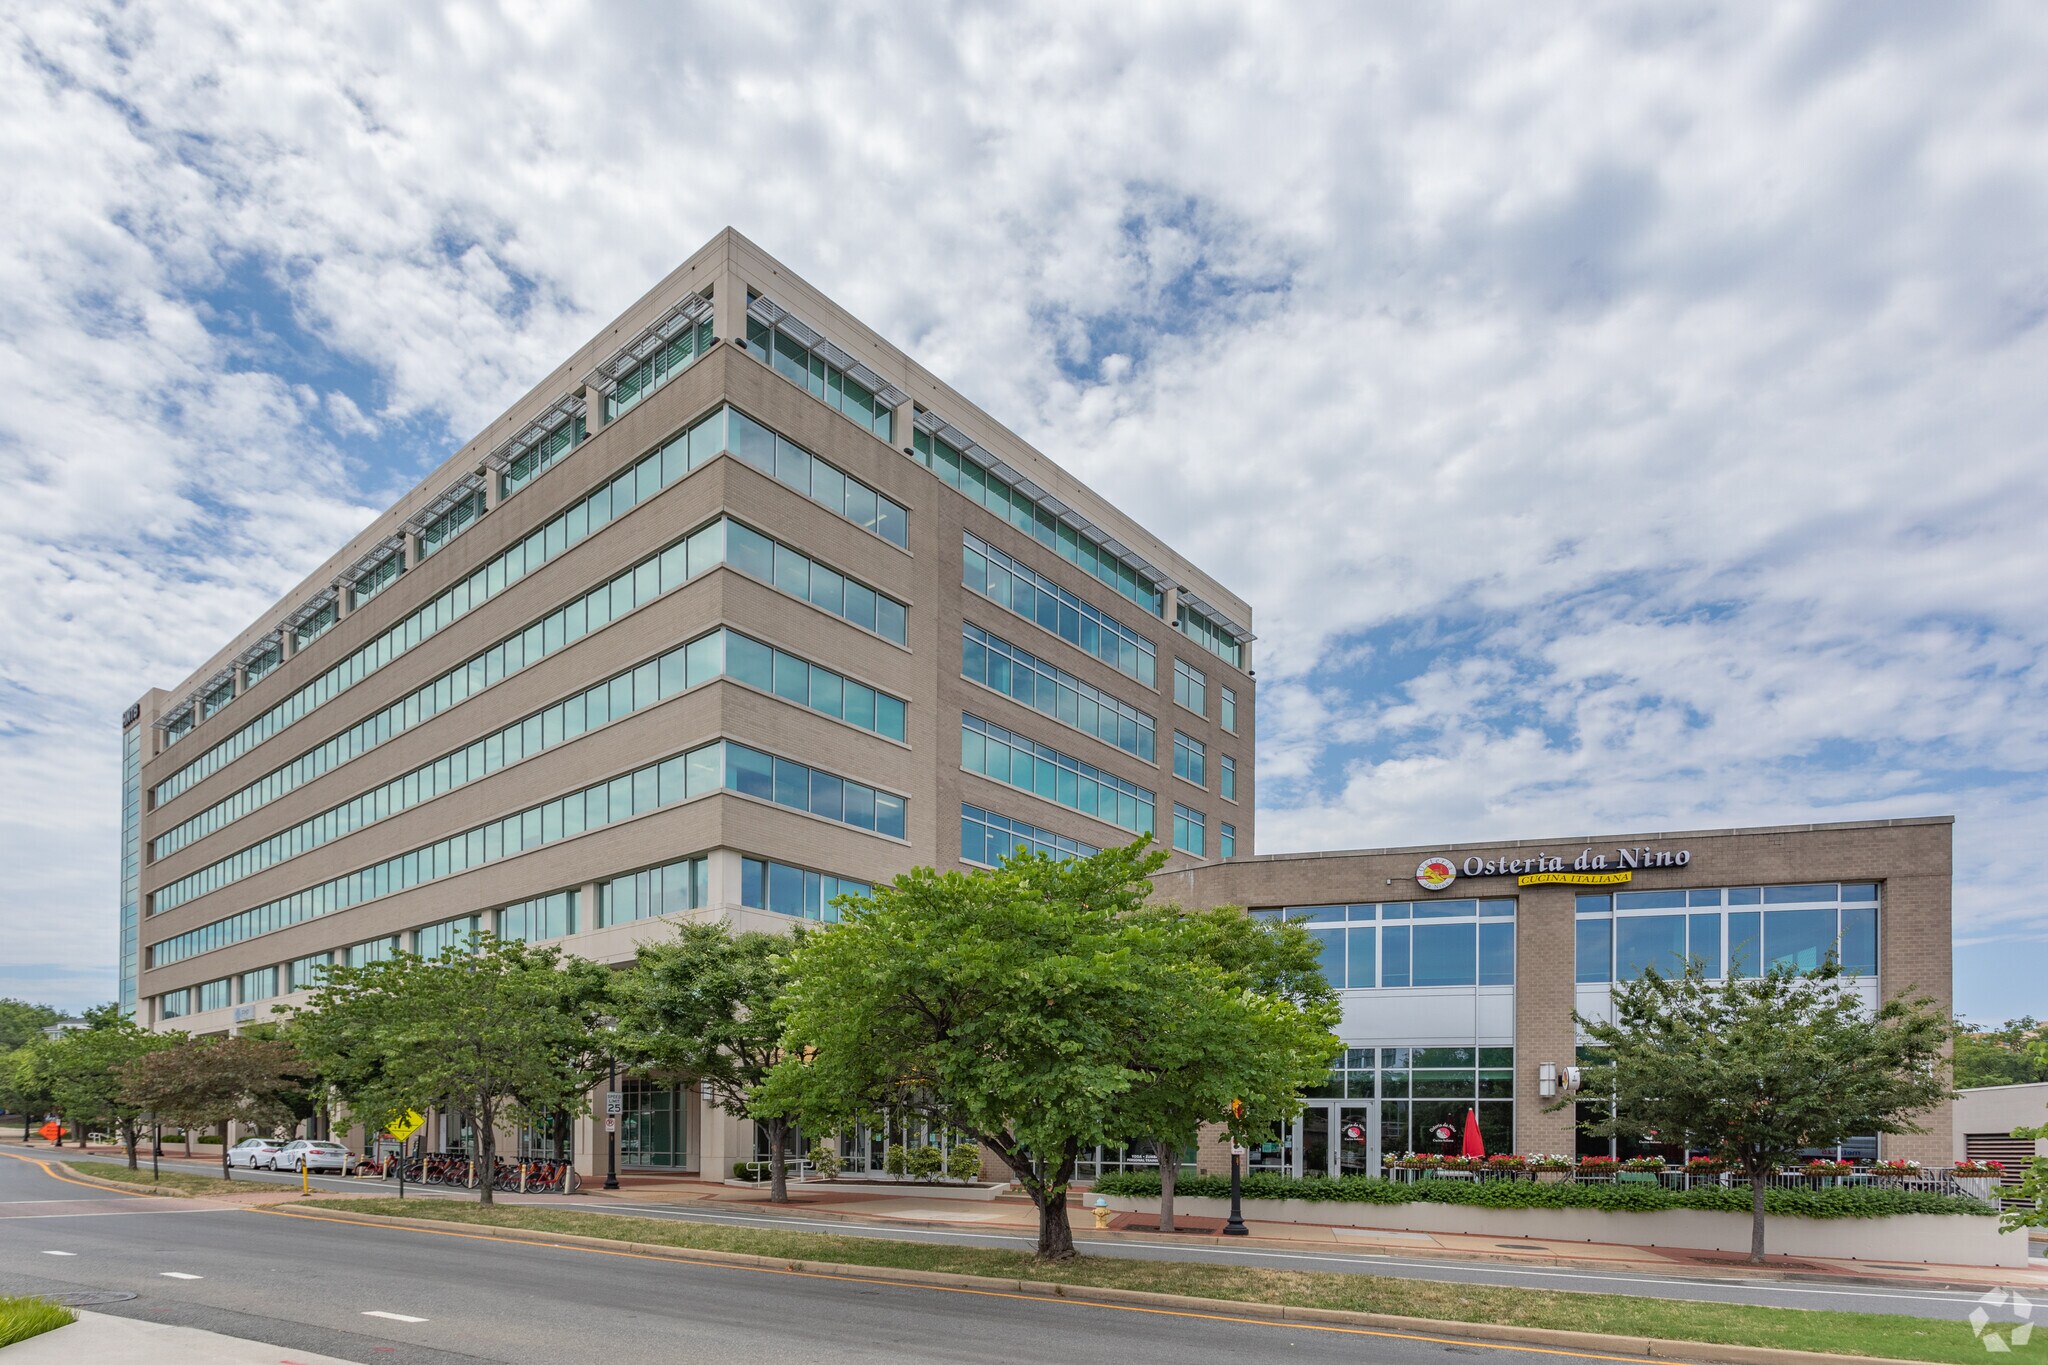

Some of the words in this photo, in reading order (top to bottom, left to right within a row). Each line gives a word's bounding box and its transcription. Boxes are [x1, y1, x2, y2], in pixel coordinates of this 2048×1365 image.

[1463, 852, 1565, 876] Osteria
[1574, 847, 1608, 871] da
[1616, 846, 1691, 869] Nino
[1521, 874, 1567, 884] CUCINA
[1571, 873, 1629, 883] ITALIANA
[608, 1104, 621, 1112] 25
